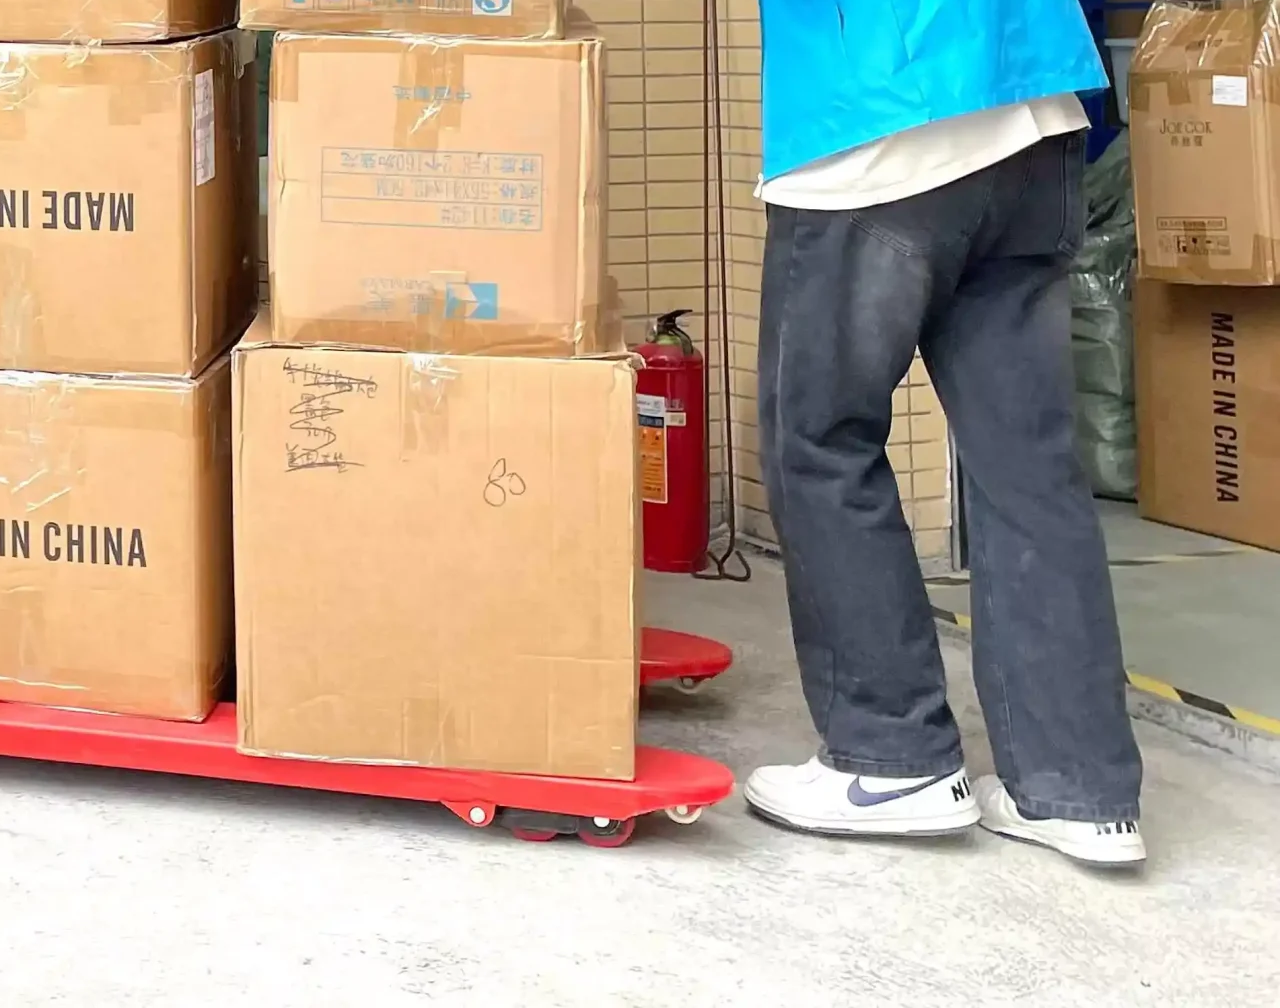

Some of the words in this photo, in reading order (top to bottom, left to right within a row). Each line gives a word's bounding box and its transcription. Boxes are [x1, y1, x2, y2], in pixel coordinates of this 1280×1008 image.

[42, 190, 134, 232] MADE
[1211, 312, 1236, 384] MADE
[1213, 390, 1237, 417] IN
[1214, 425, 1239, 502] CHINA
[0, 518, 30, 559] IN
[43, 521, 147, 567] CHINA
